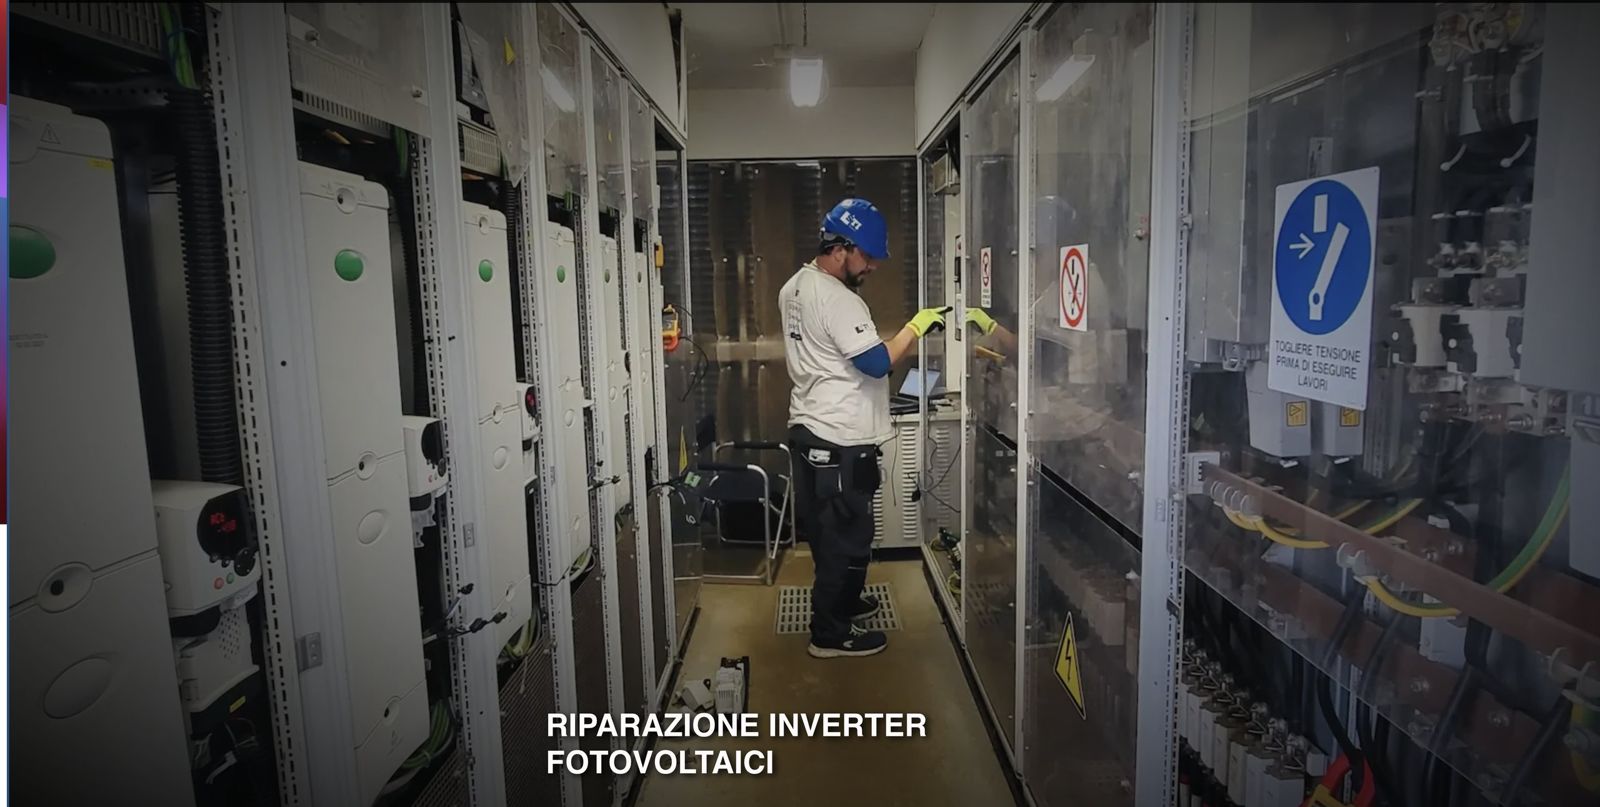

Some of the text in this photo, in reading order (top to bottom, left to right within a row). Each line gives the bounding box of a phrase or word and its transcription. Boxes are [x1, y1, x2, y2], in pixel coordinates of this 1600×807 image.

[1275, 340, 1361, 363] TOGLIERE TENSIONE
[1276, 355, 1357, 380] PRIMA DI ESEGUIRE
[1298, 374, 1328, 391] LAVORI
